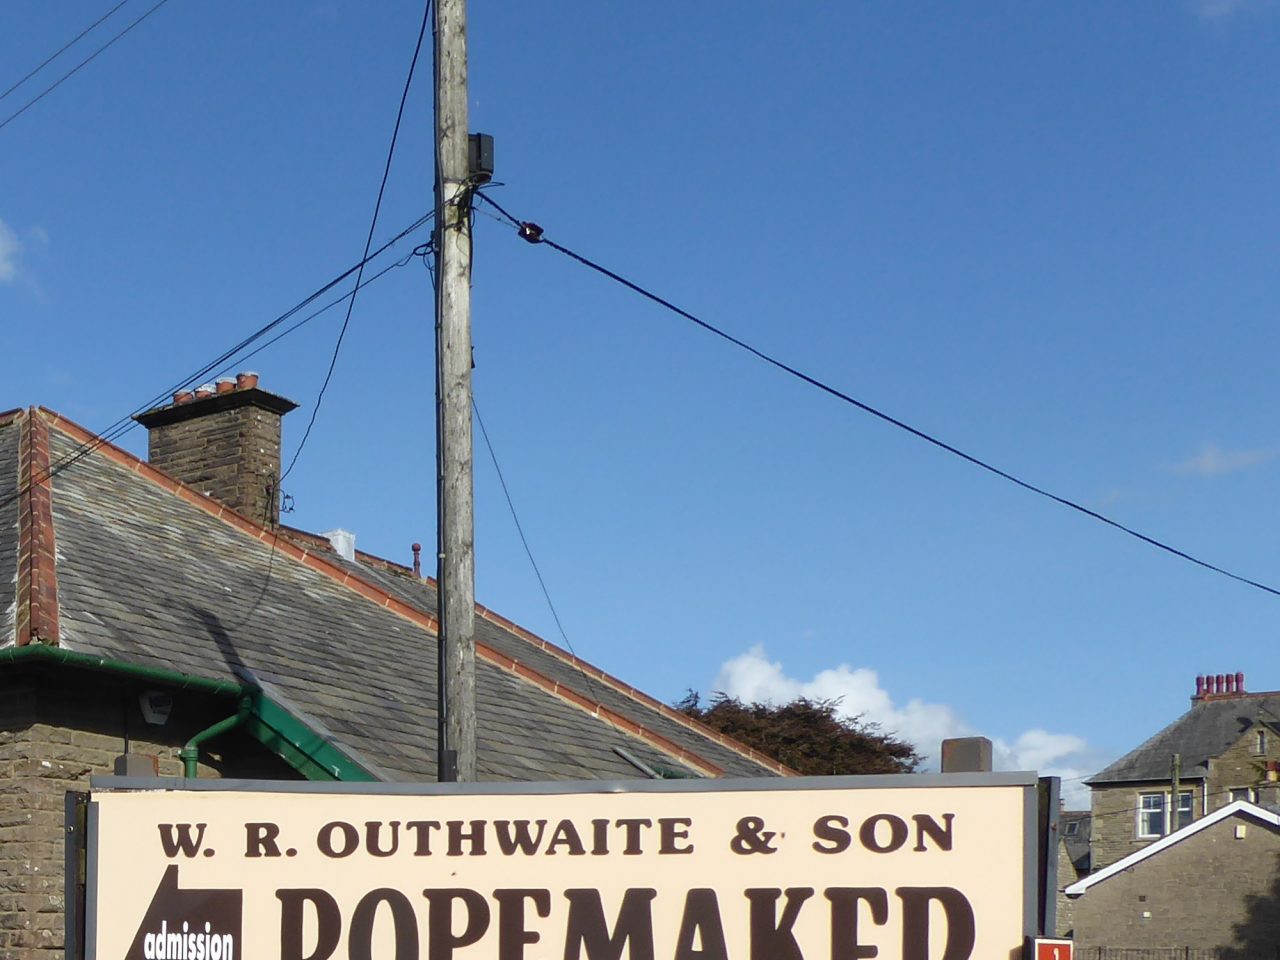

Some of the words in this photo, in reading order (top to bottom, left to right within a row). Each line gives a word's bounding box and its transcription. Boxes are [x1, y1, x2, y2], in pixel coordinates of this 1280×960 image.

[157, 823, 215, 858] W.
[244, 822, 298, 858] R.
[316, 817, 694, 859] OUTHWAITE
[730, 816, 778, 856] &
[812, 813, 955, 855] SON
